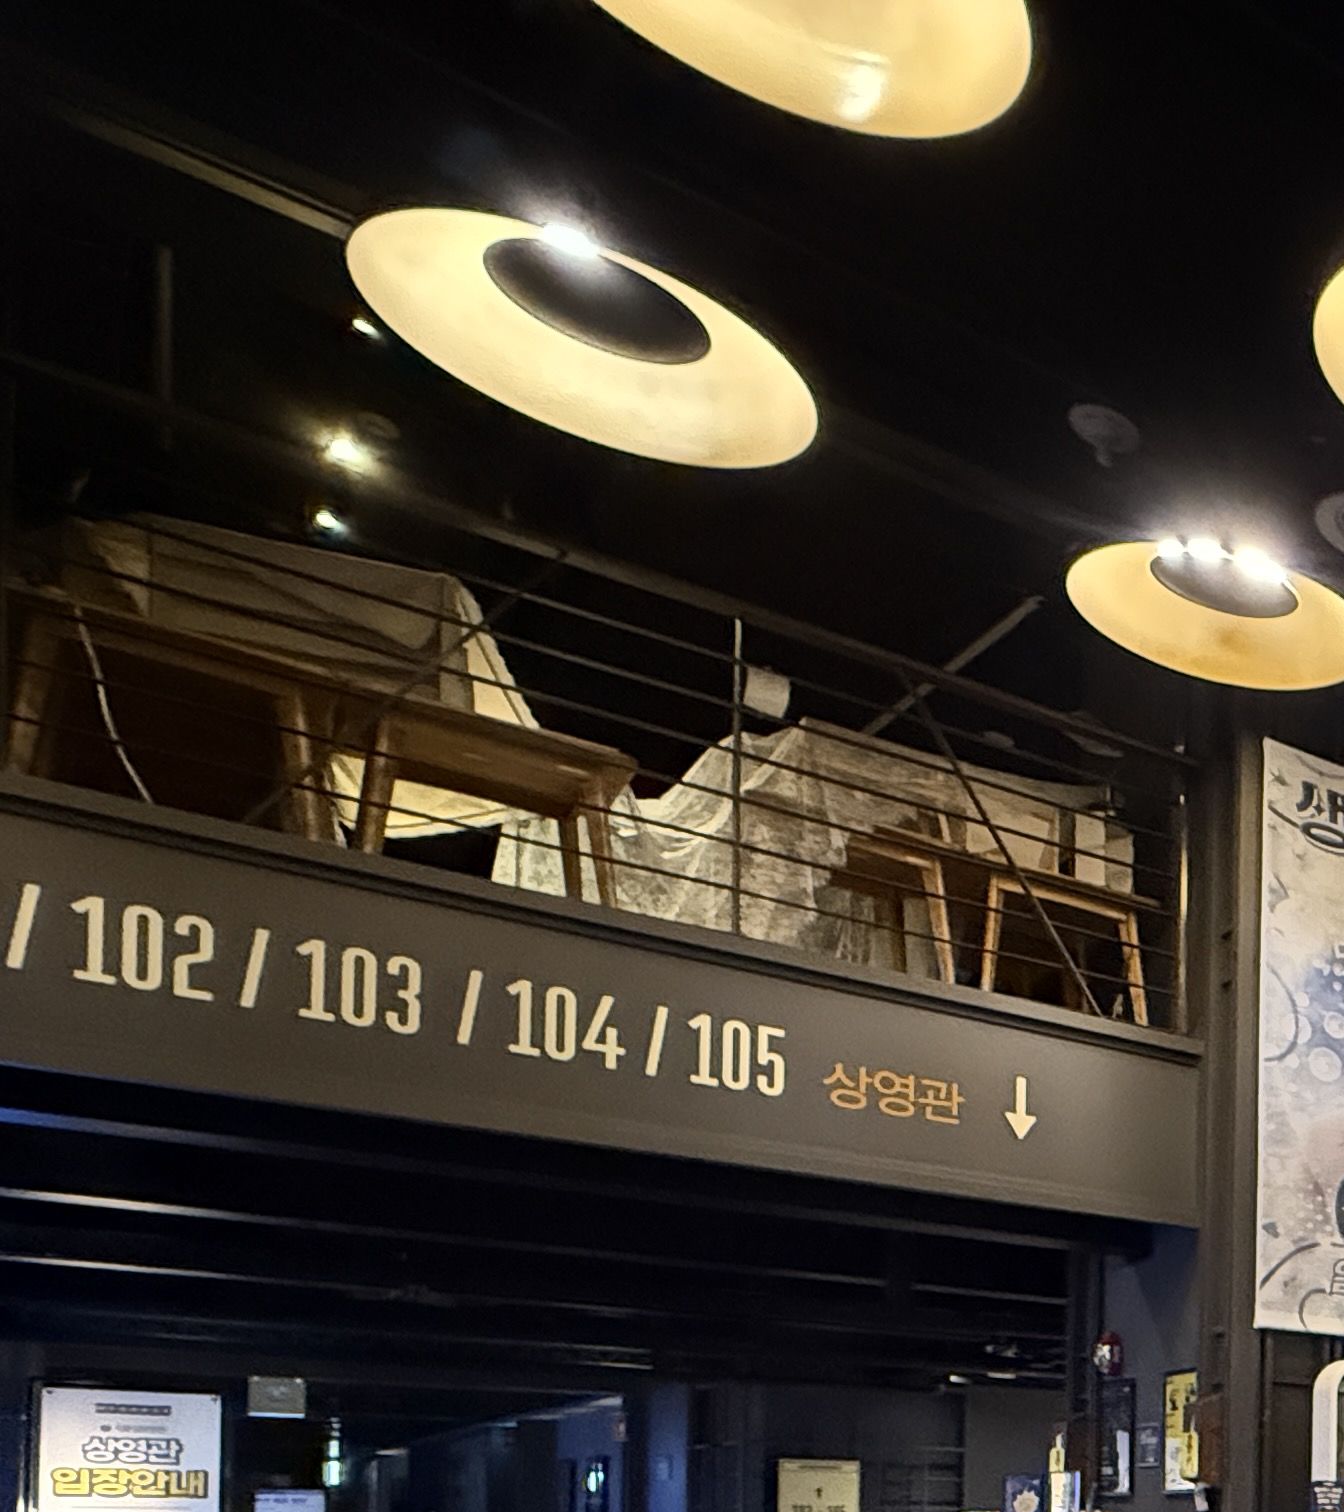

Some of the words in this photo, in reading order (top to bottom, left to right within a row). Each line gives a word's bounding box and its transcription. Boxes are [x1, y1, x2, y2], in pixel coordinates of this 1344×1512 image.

[70, 895, 216, 1003] 102
[295, 938, 422, 1035] 103
[506, 978, 626, 1070] 104
[687, 1012, 786, 1097] 105
[822, 1060, 966, 1127] 상영관
[82, 1436, 183, 1465] 상영관
